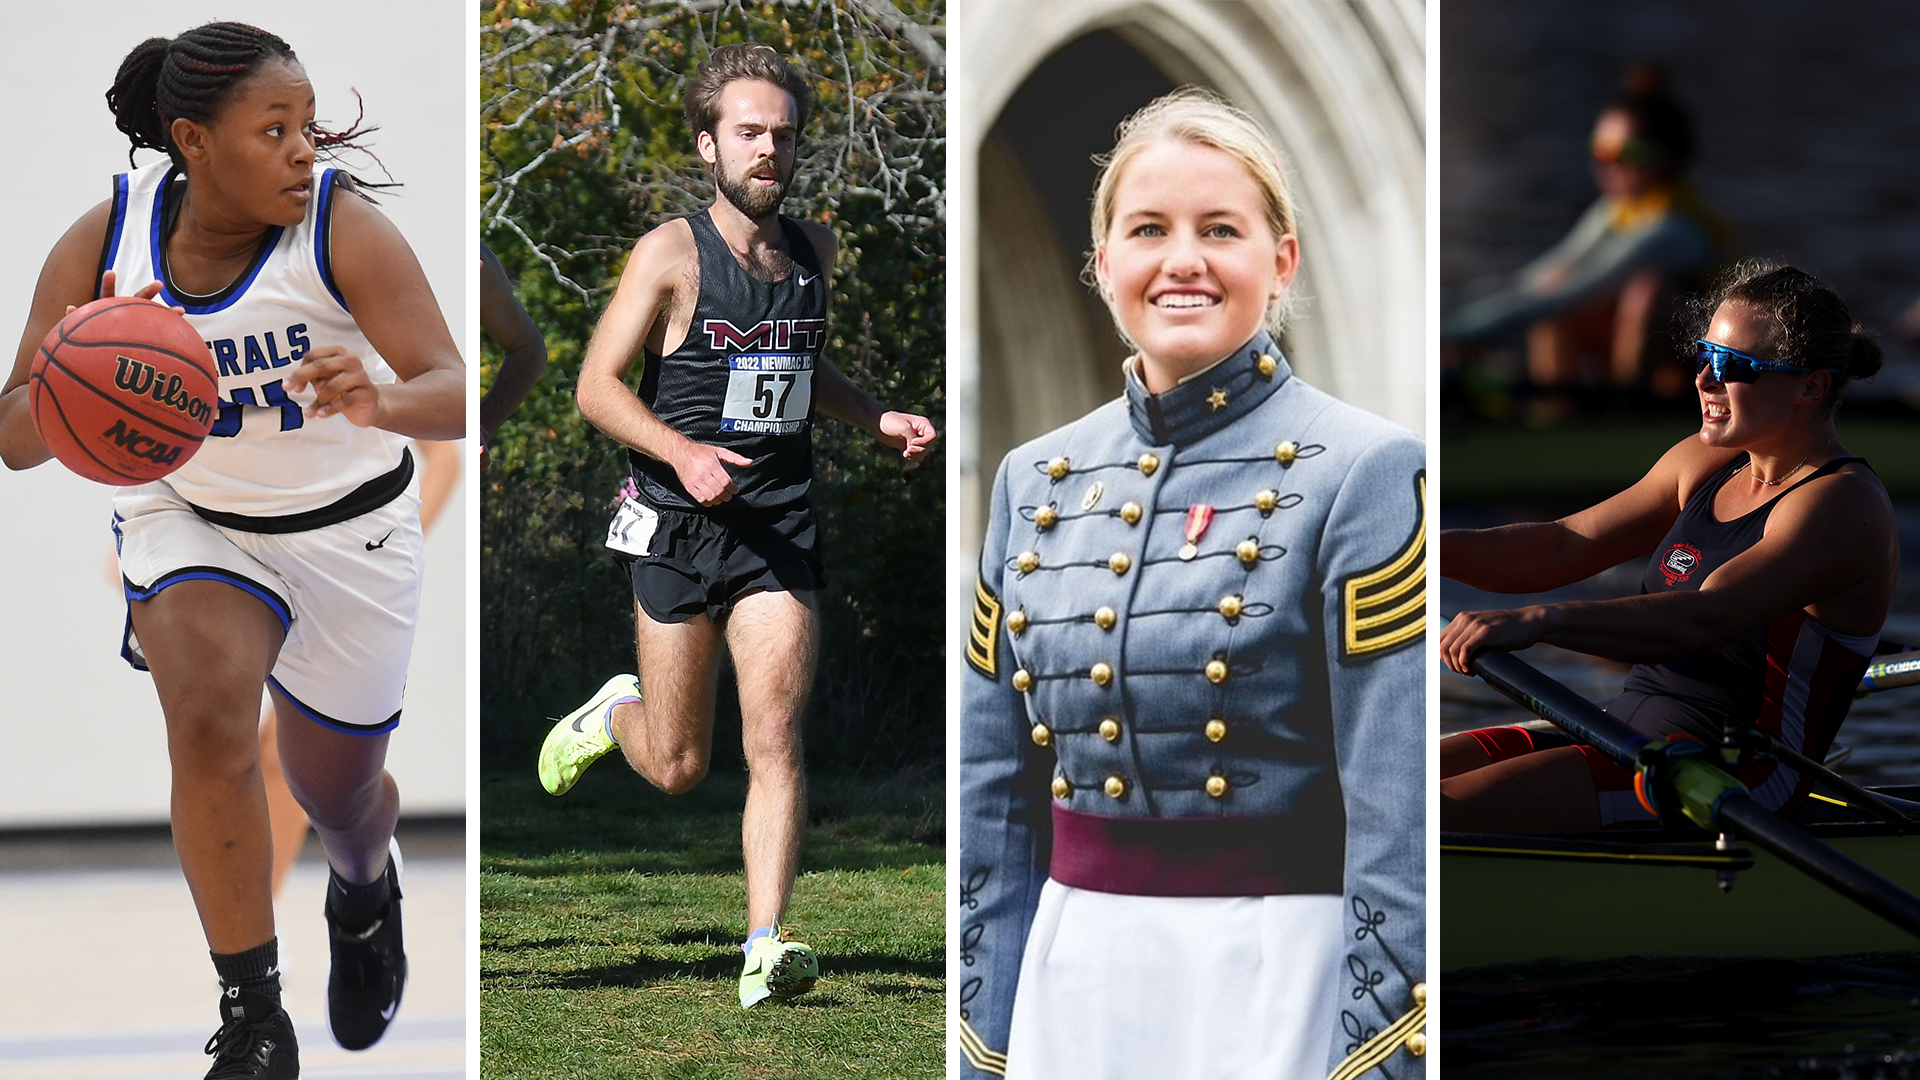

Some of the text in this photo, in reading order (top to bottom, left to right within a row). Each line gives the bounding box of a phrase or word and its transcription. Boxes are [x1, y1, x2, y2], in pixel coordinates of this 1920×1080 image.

[205, 323, 310, 377] RALS
[703, 319, 825, 352] MIT
[735, 356, 760, 370] 2022
[761, 356, 801, 370] NEWMAC
[114, 355, 212, 427] Wilson
[752, 373, 796, 419] 57
[102, 418, 183, 466] NCAA
[733, 419, 800, 433] CHAMPIONSHIP
